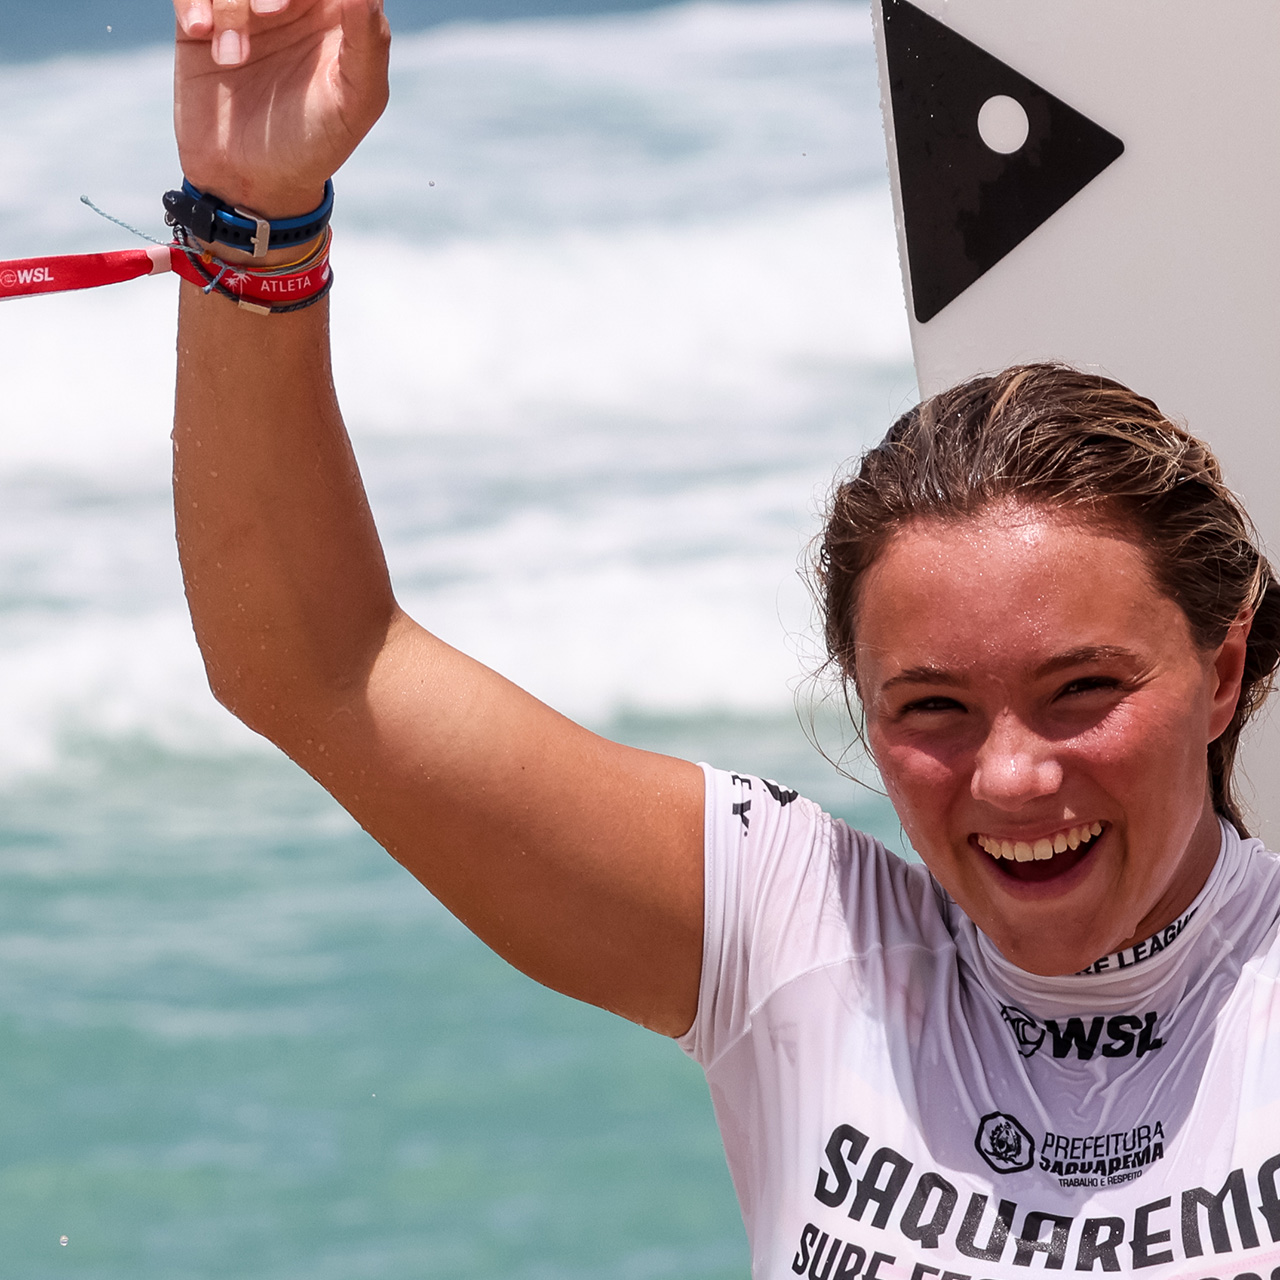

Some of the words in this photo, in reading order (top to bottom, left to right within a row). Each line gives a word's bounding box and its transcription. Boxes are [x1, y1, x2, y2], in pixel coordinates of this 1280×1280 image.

[17, 267, 54, 284] WSL
[260, 275, 312, 292] ATLETA
[1117, 906, 1199, 969] LEAGU
[1043, 1011, 1165, 1060] WSL
[1040, 1120, 1166, 1160] PREFEITURA
[1038, 1142, 1165, 1176] SAQUAREMA
[1058, 1177, 1099, 1187] TRABALHO
[1100, 1178, 1106, 1187] E
[1107, 1169, 1143, 1186] RESPEITO
